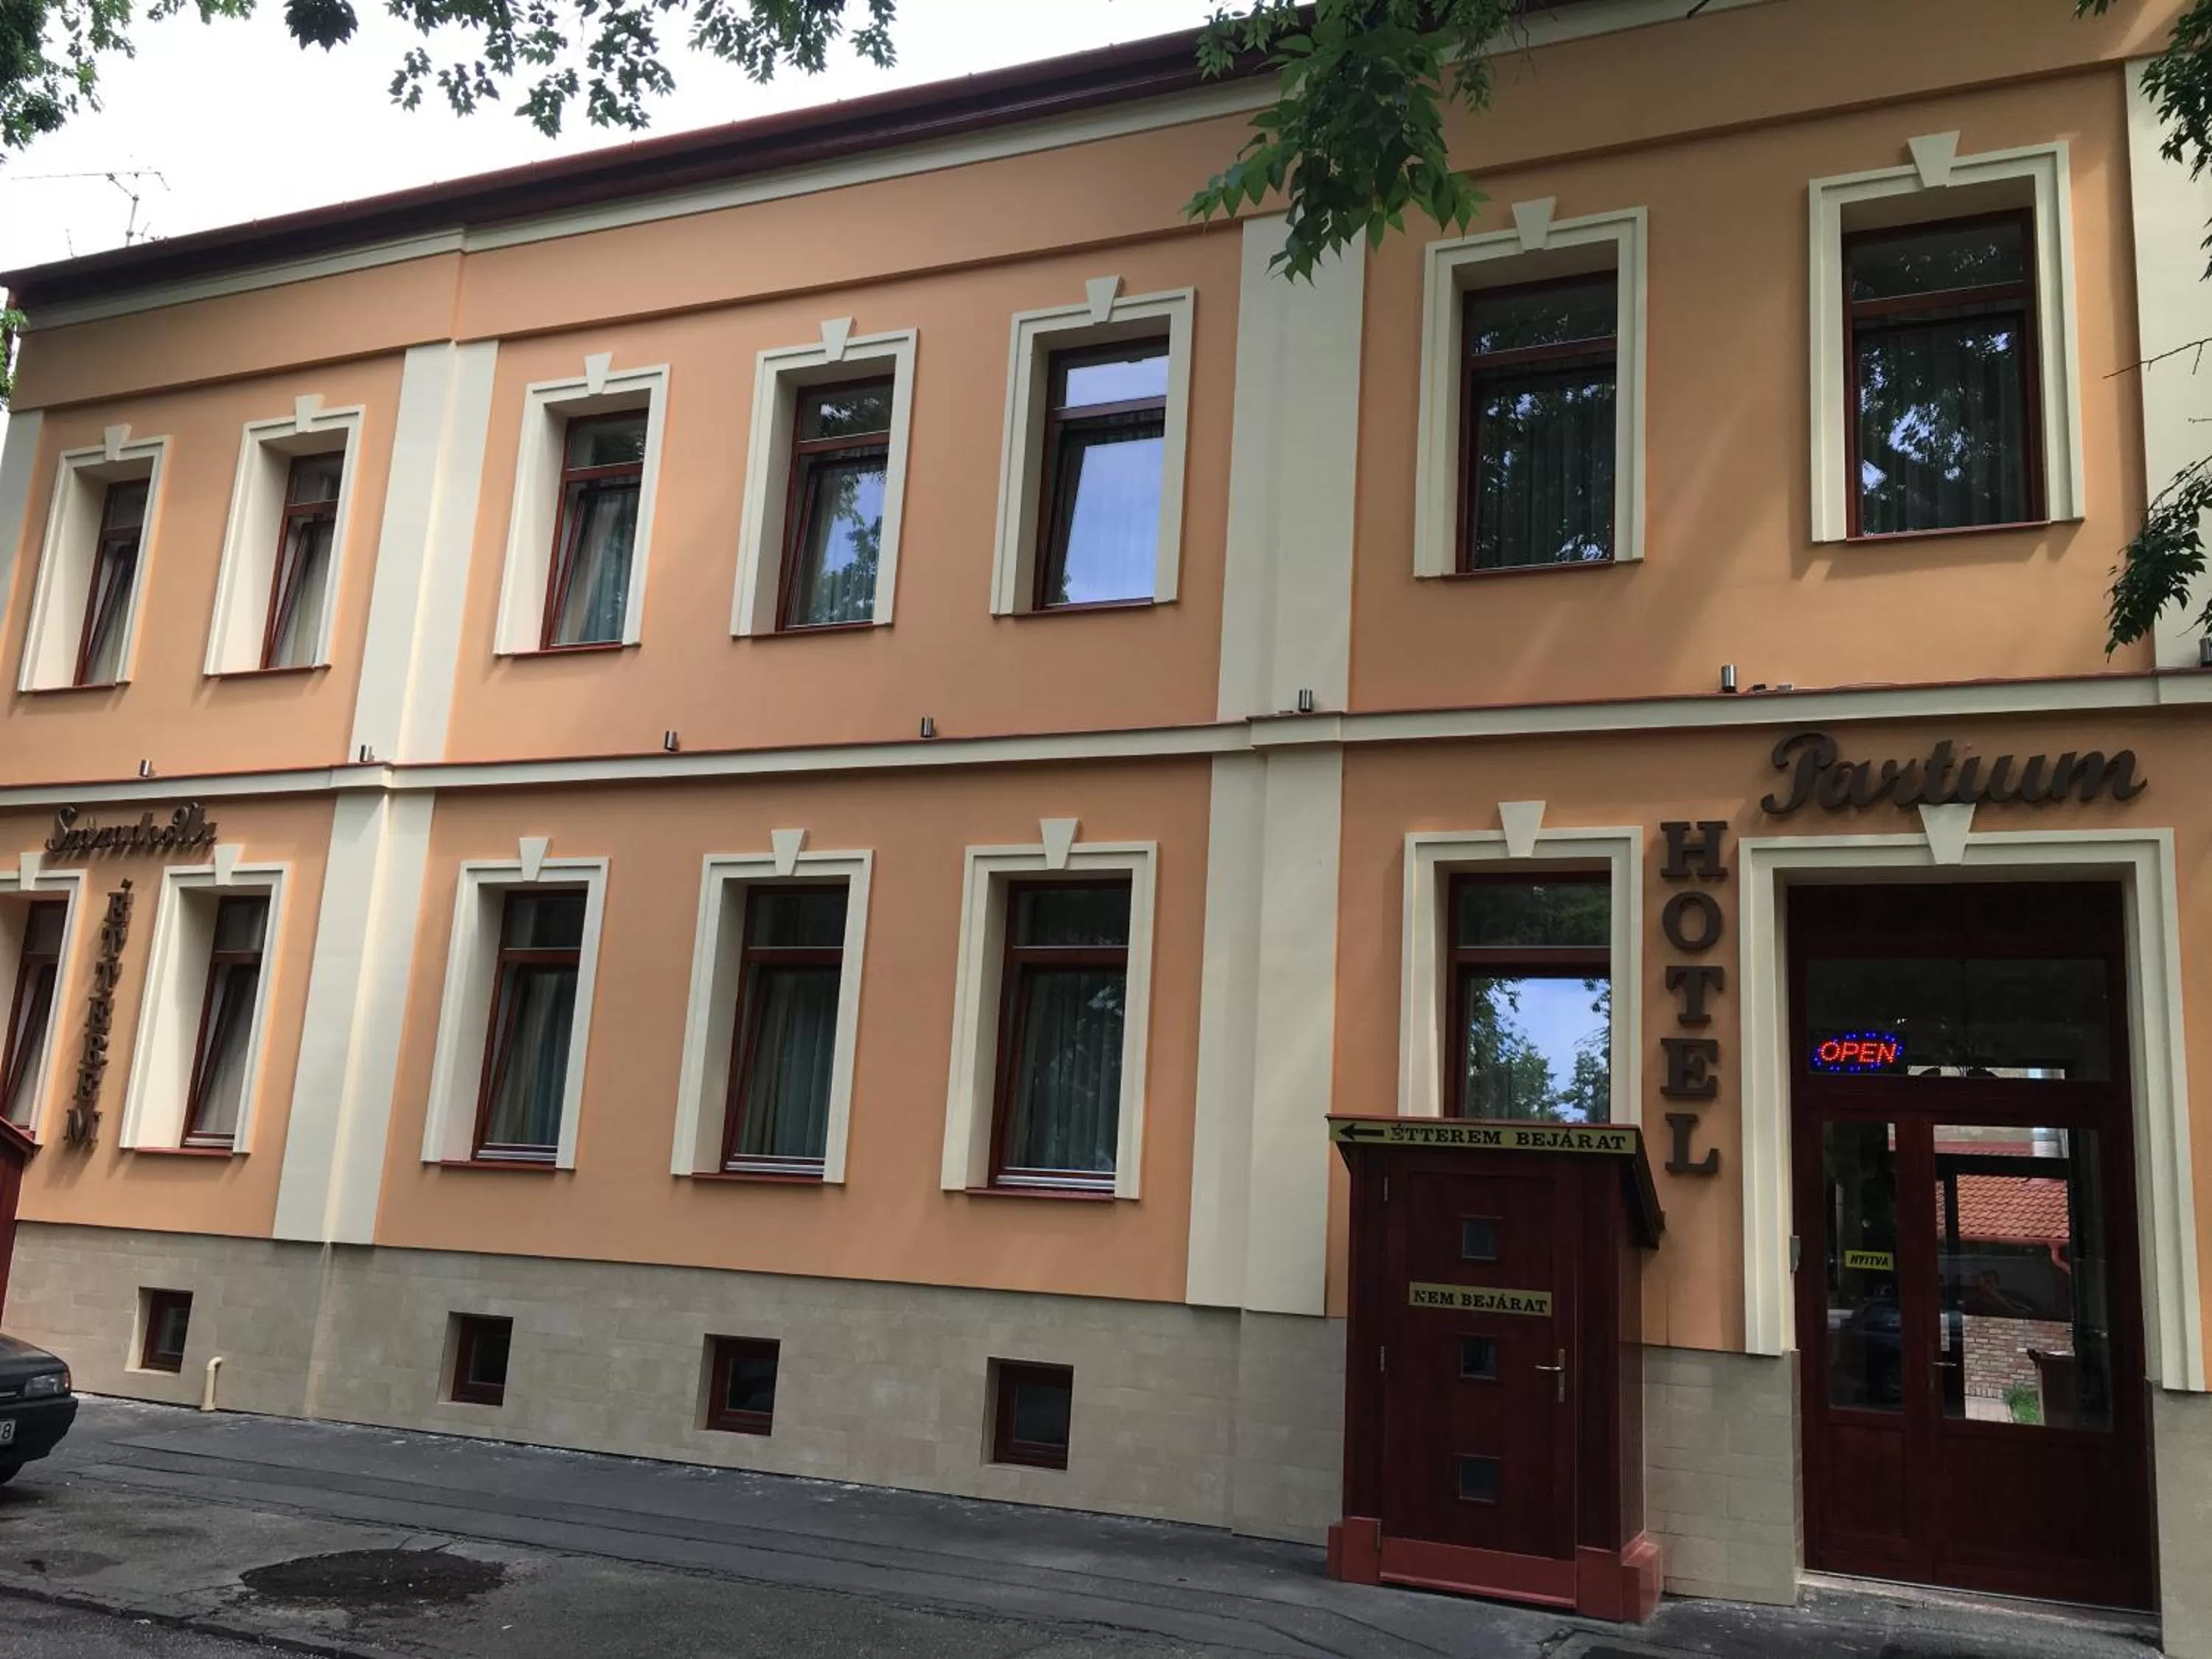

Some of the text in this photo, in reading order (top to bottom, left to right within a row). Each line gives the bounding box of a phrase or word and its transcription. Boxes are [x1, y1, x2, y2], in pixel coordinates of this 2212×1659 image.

[1761, 732, 2147, 814] Partium
[1660, 821, 1728, 1175] HOTEL
[1820, 1041, 1897, 1063] OPEN
[1390, 1123, 1627, 1150] ÉTTEREM BEJÁRAT
[1849, 1254, 1888, 1267] NYITVA
[1413, 1290, 1548, 1312] NEM BEJÁRAT
